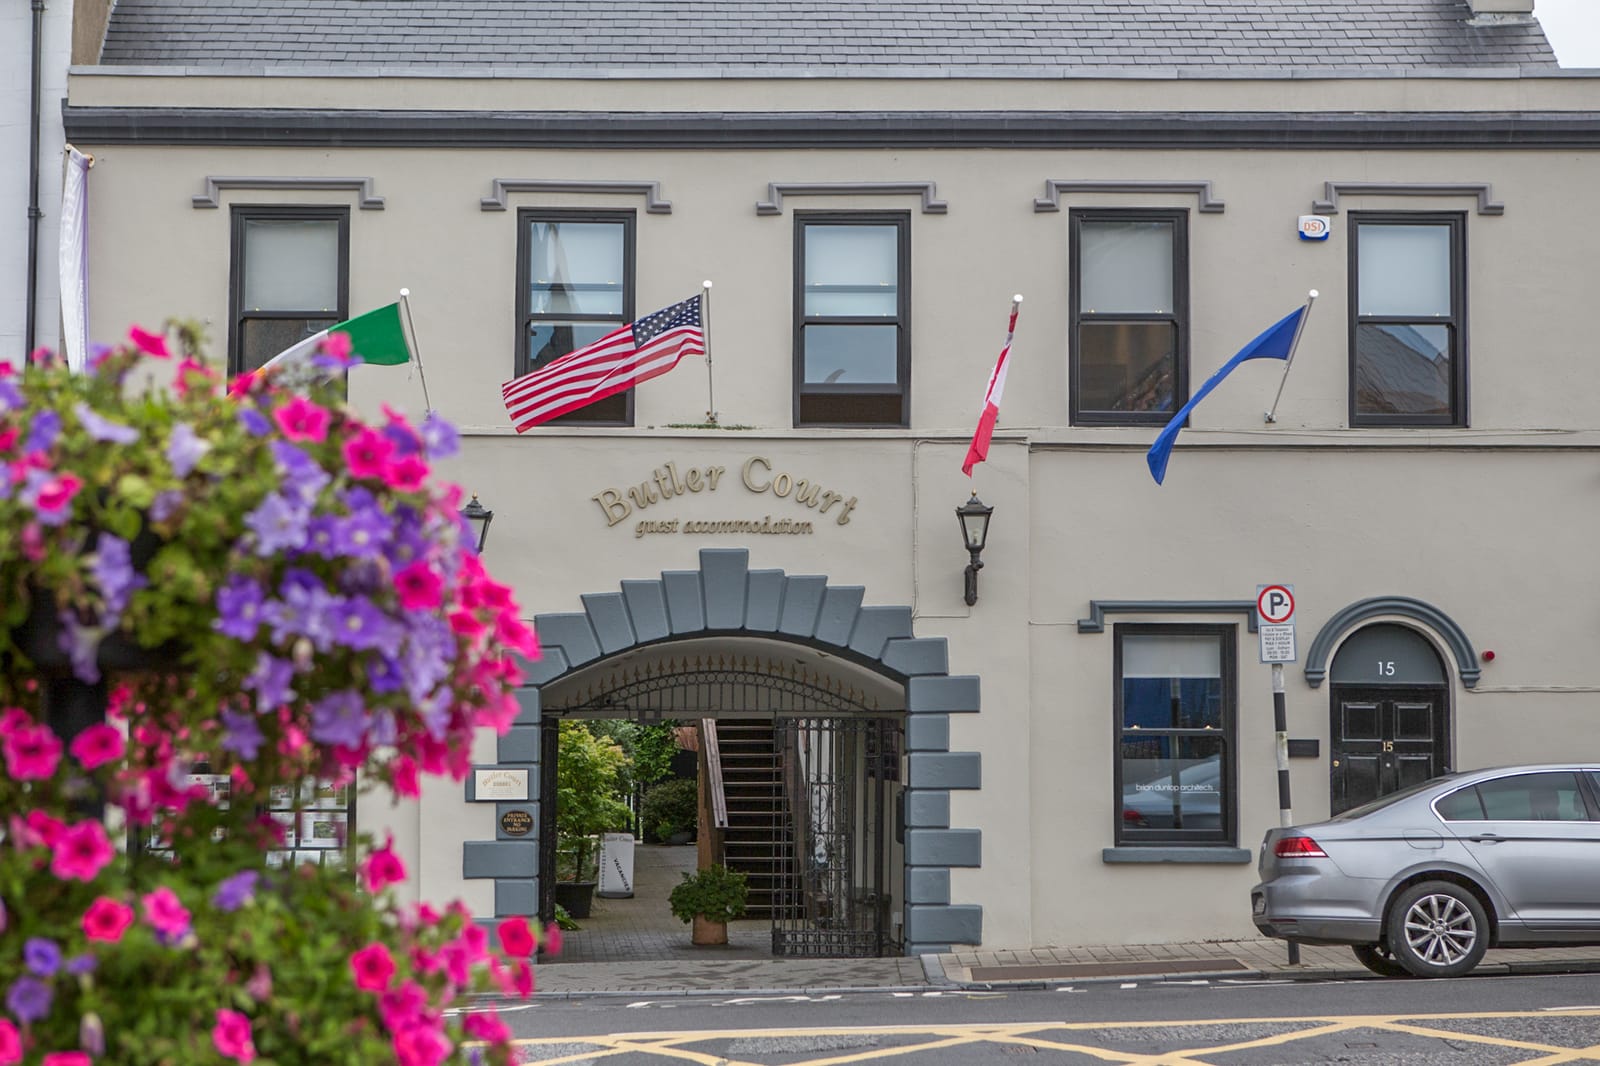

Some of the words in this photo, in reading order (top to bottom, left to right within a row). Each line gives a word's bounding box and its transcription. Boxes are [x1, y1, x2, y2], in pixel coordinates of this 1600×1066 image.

[1303, 221, 1321, 231] DSI
[592, 461, 725, 527] Butler
[741, 456, 858, 525] Court
[635, 518, 679, 538] guest
[683, 515, 814, 535] accommodation
[1377, 661, 1396, 676] 15
[1382, 740, 1394, 752] 15
[613, 857, 631, 891] VACANCIES
